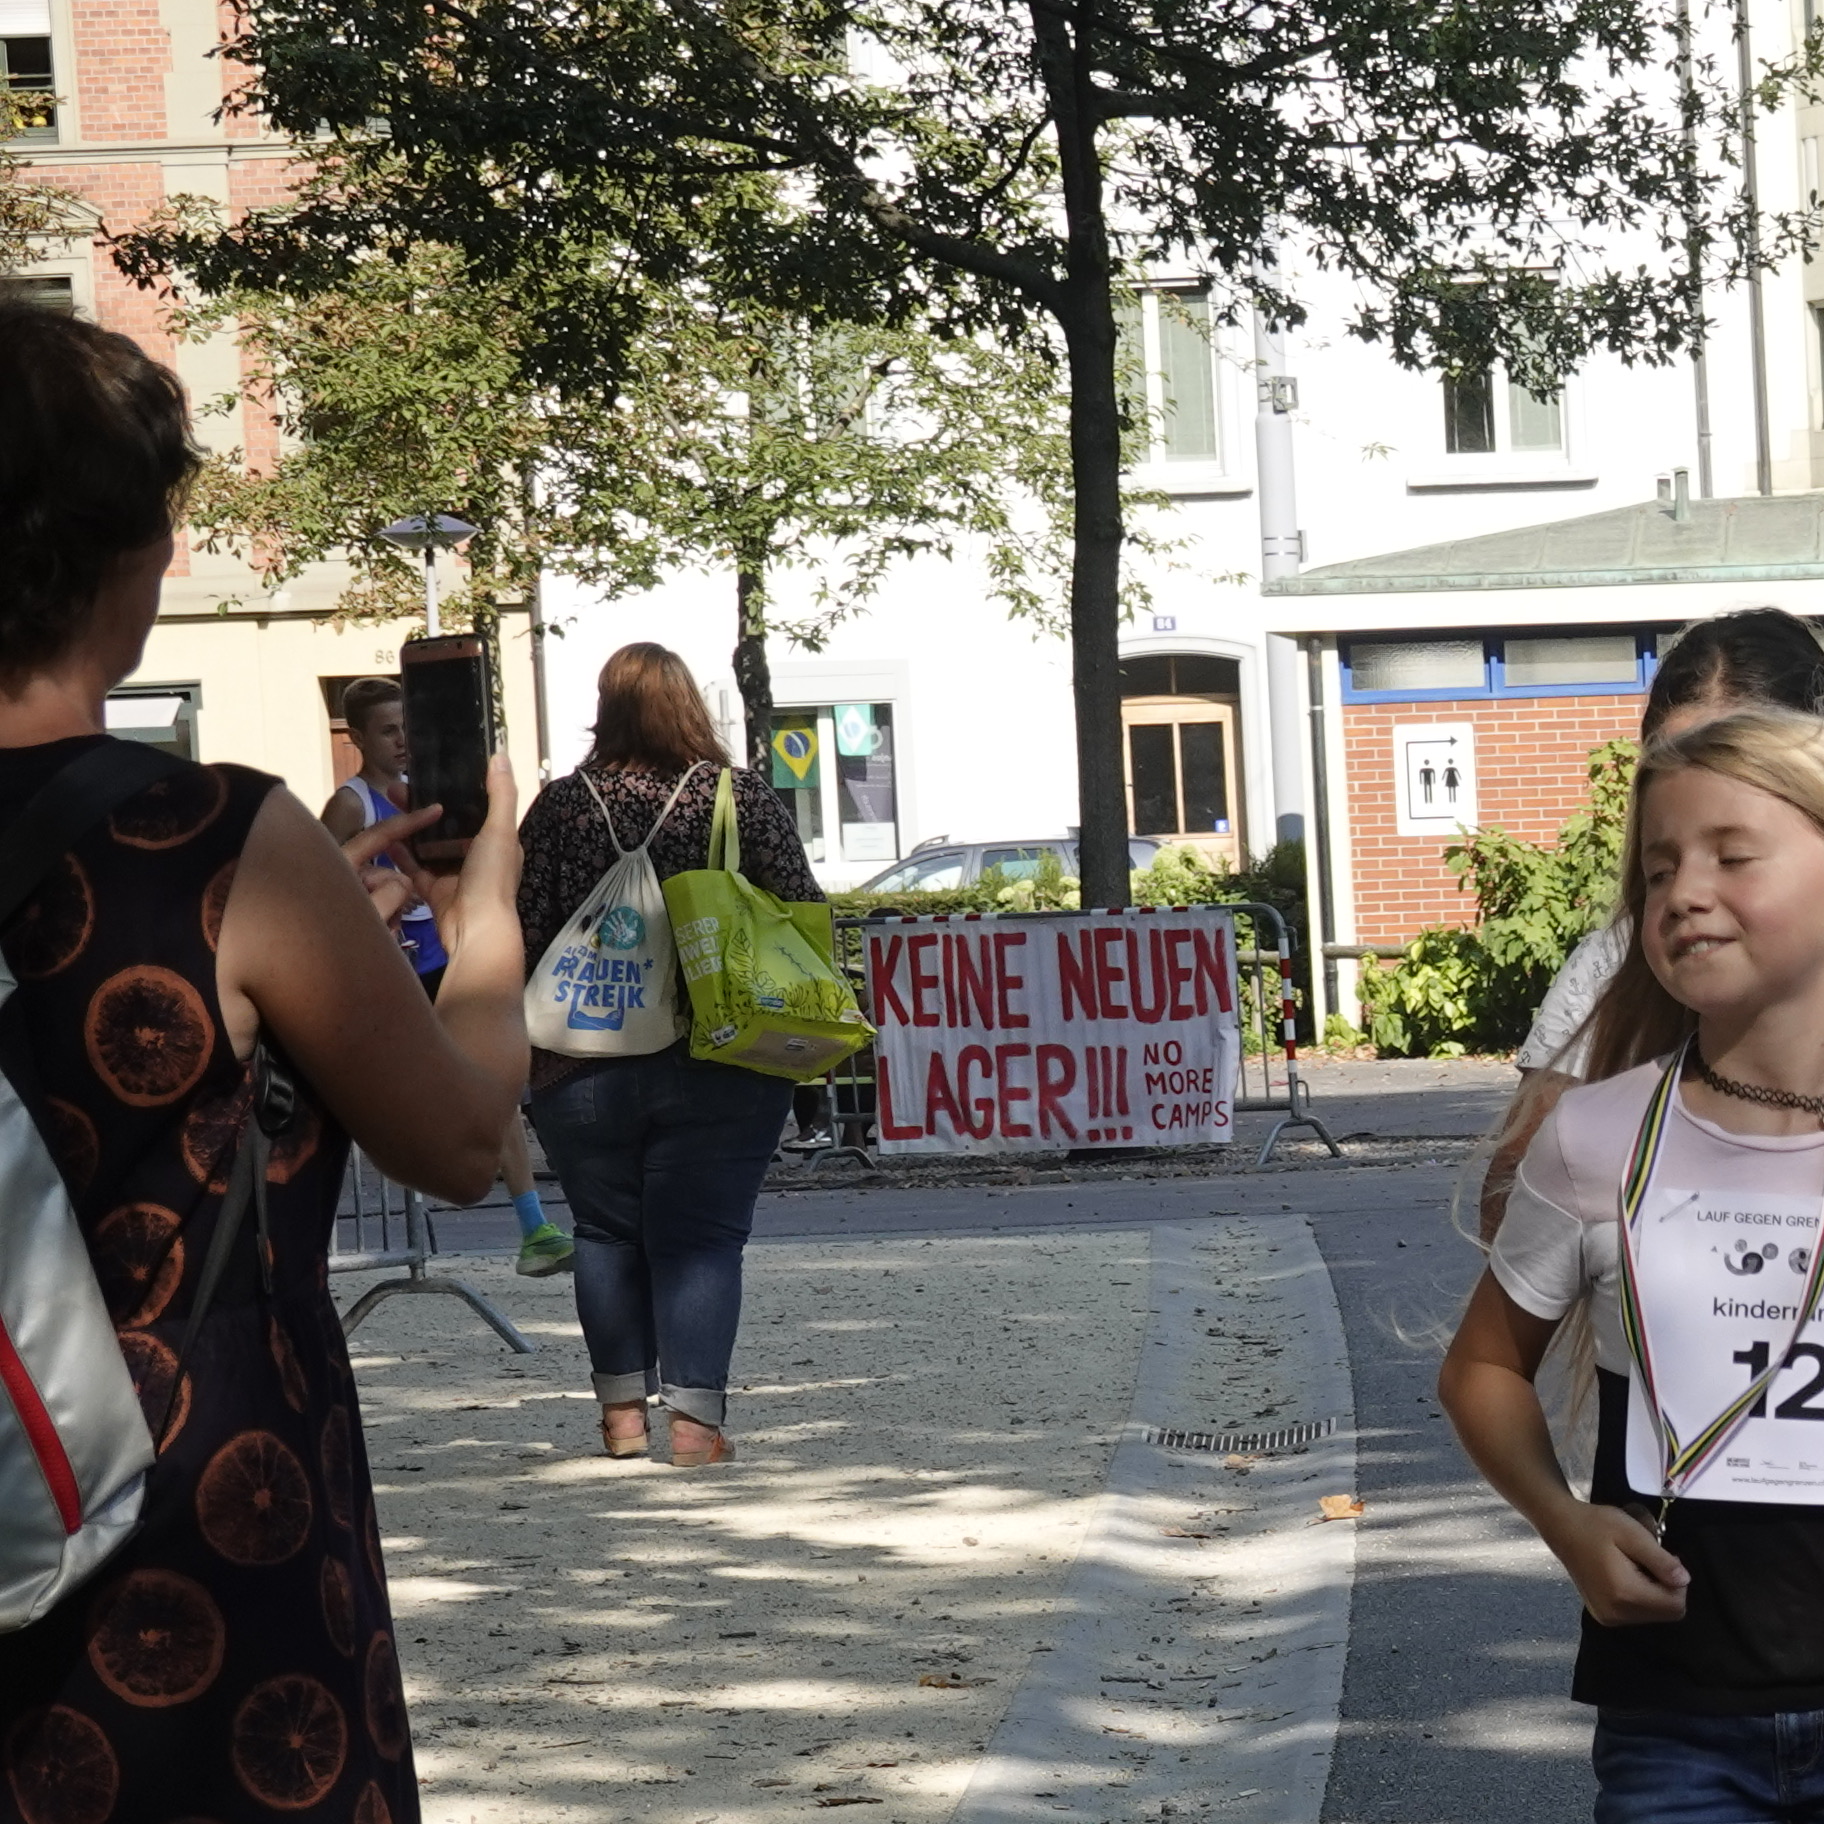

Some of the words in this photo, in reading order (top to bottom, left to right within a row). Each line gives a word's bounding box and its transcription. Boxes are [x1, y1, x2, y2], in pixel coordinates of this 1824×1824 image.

[375, 649, 395, 664] 86
[870, 932, 1031, 1030] KEINE
[1057, 927, 1233, 1024] NEUEN
[554, 981, 645, 1008] STREIK
[1143, 1040, 1182, 1067] NO
[877, 1043, 1133, 1143] LAGER!!!
[1144, 1068, 1214, 1095] MORE
[1151, 1101, 1229, 1130] CAMPS
[1697, 1211, 1730, 1222] LAUF
[1734, 1213, 1782, 1226] GEGEN
